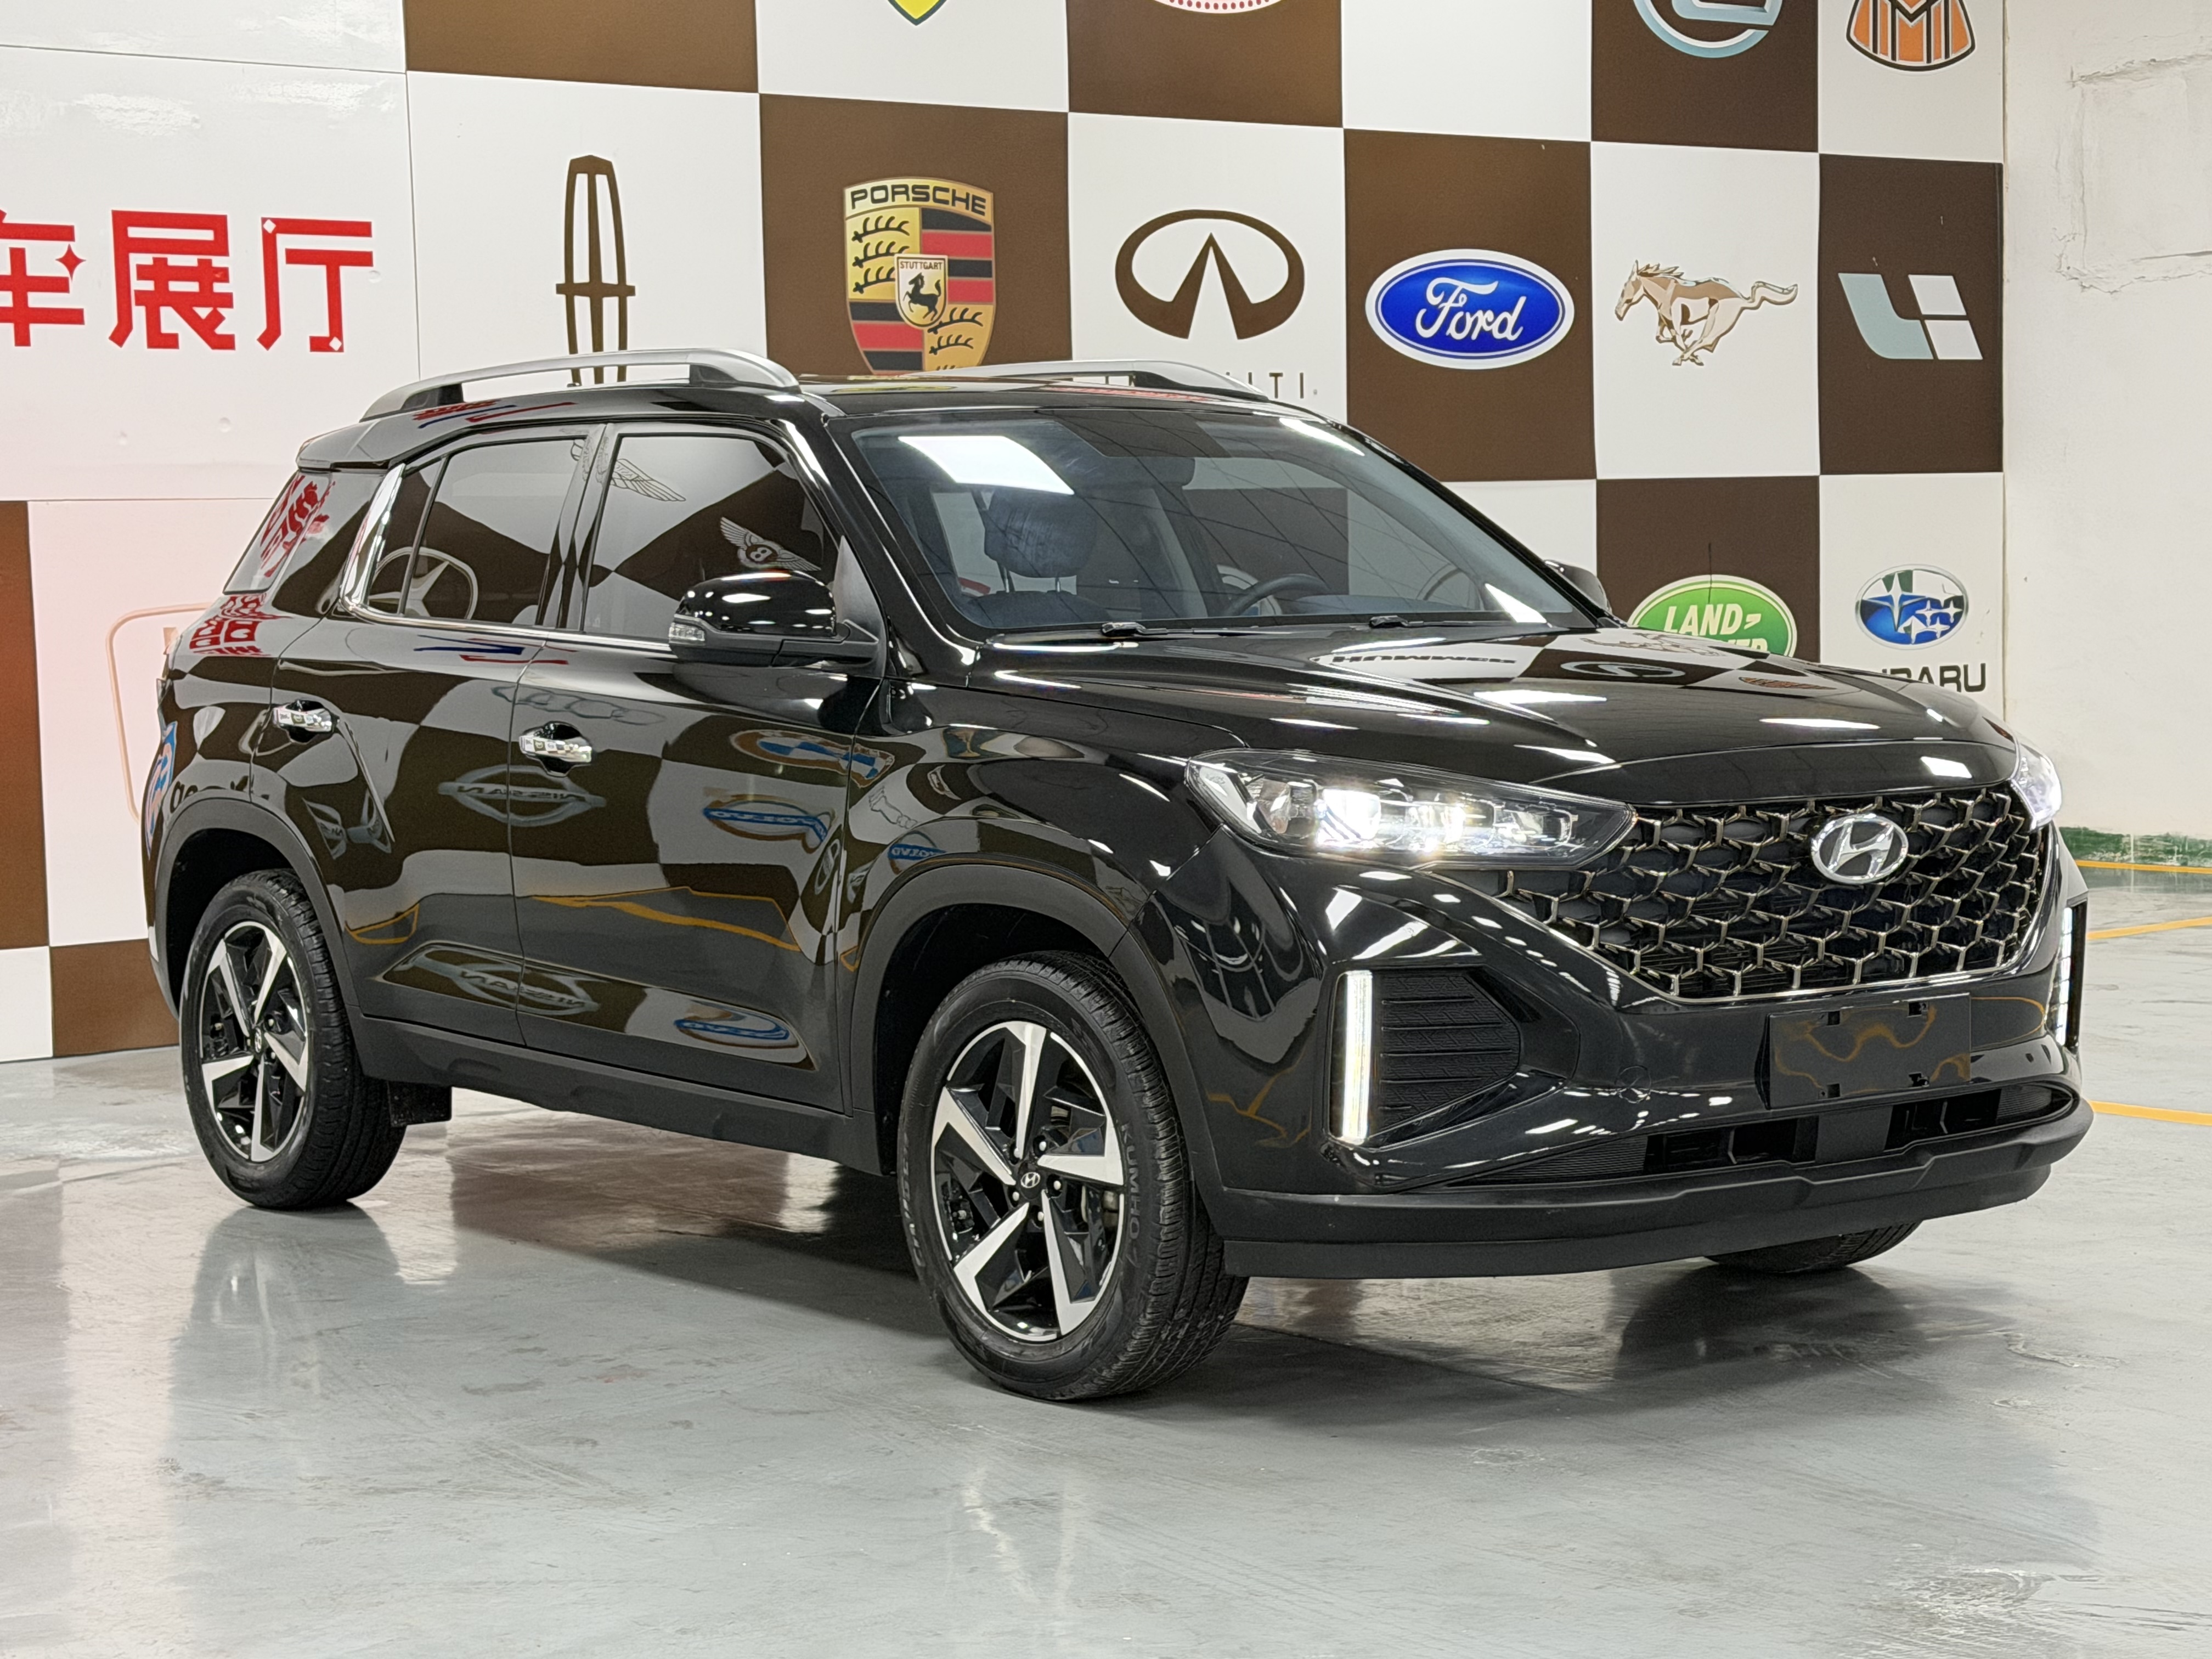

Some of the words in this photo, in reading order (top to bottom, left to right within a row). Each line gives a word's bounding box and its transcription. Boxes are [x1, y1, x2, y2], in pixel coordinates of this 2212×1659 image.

[850, 184, 986, 217] PORSCHE
[900, 261, 943, 270] STUTTGART
[1415, 277, 1527, 341] Ford
